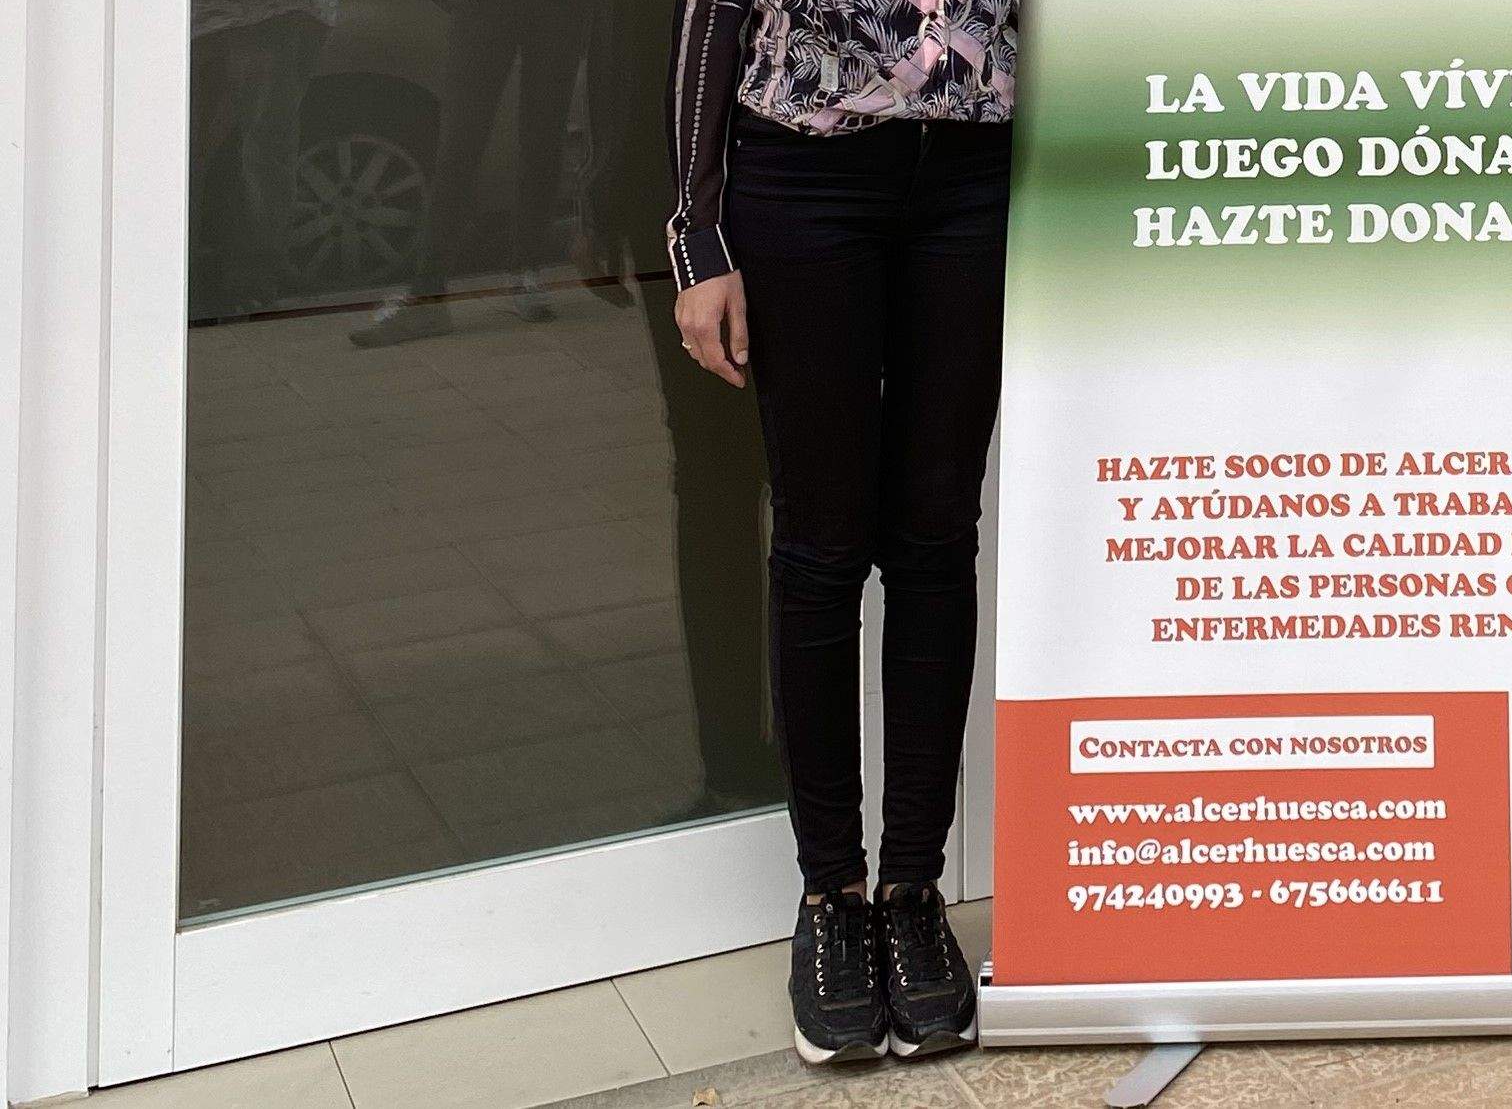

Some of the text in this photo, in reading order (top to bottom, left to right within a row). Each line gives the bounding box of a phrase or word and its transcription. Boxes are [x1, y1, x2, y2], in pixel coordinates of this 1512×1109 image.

[1145, 72, 1226, 114] LA
[1237, 70, 1389, 112] VIDA
[1144, 137, 1344, 180] LUEGO
[1132, 203, 1334, 248] HAZTE
[1096, 455, 1217, 483] HAZTE
[1224, 453, 1332, 480] SOCIO
[1339, 452, 1388, 477] DE
[1395, 451, 1512, 476] ALCER
[1117, 497, 1144, 522] Y
[1150, 488, 1351, 521] AYÚDANOS
[1358, 492, 1386, 517] A
[1105, 535, 1279, 563] MEJORAR
[1286, 533, 1335, 559] LA
[1342, 531, 1503, 558] CALIDAD
[1175, 576, 1224, 601] DE
[1231, 574, 1301, 600] LAS
[1308, 572, 1497, 599] PERSONAS
[1150, 613, 1441, 642] ENFERMEDADES
[1067, 795, 1447, 825] www.alcerhuesca.com
[1068, 837, 1435, 866] info@alcerhuesca.com
[1067, 882, 1244, 912] 974240993
[1269, 878, 1444, 908] 675666611
